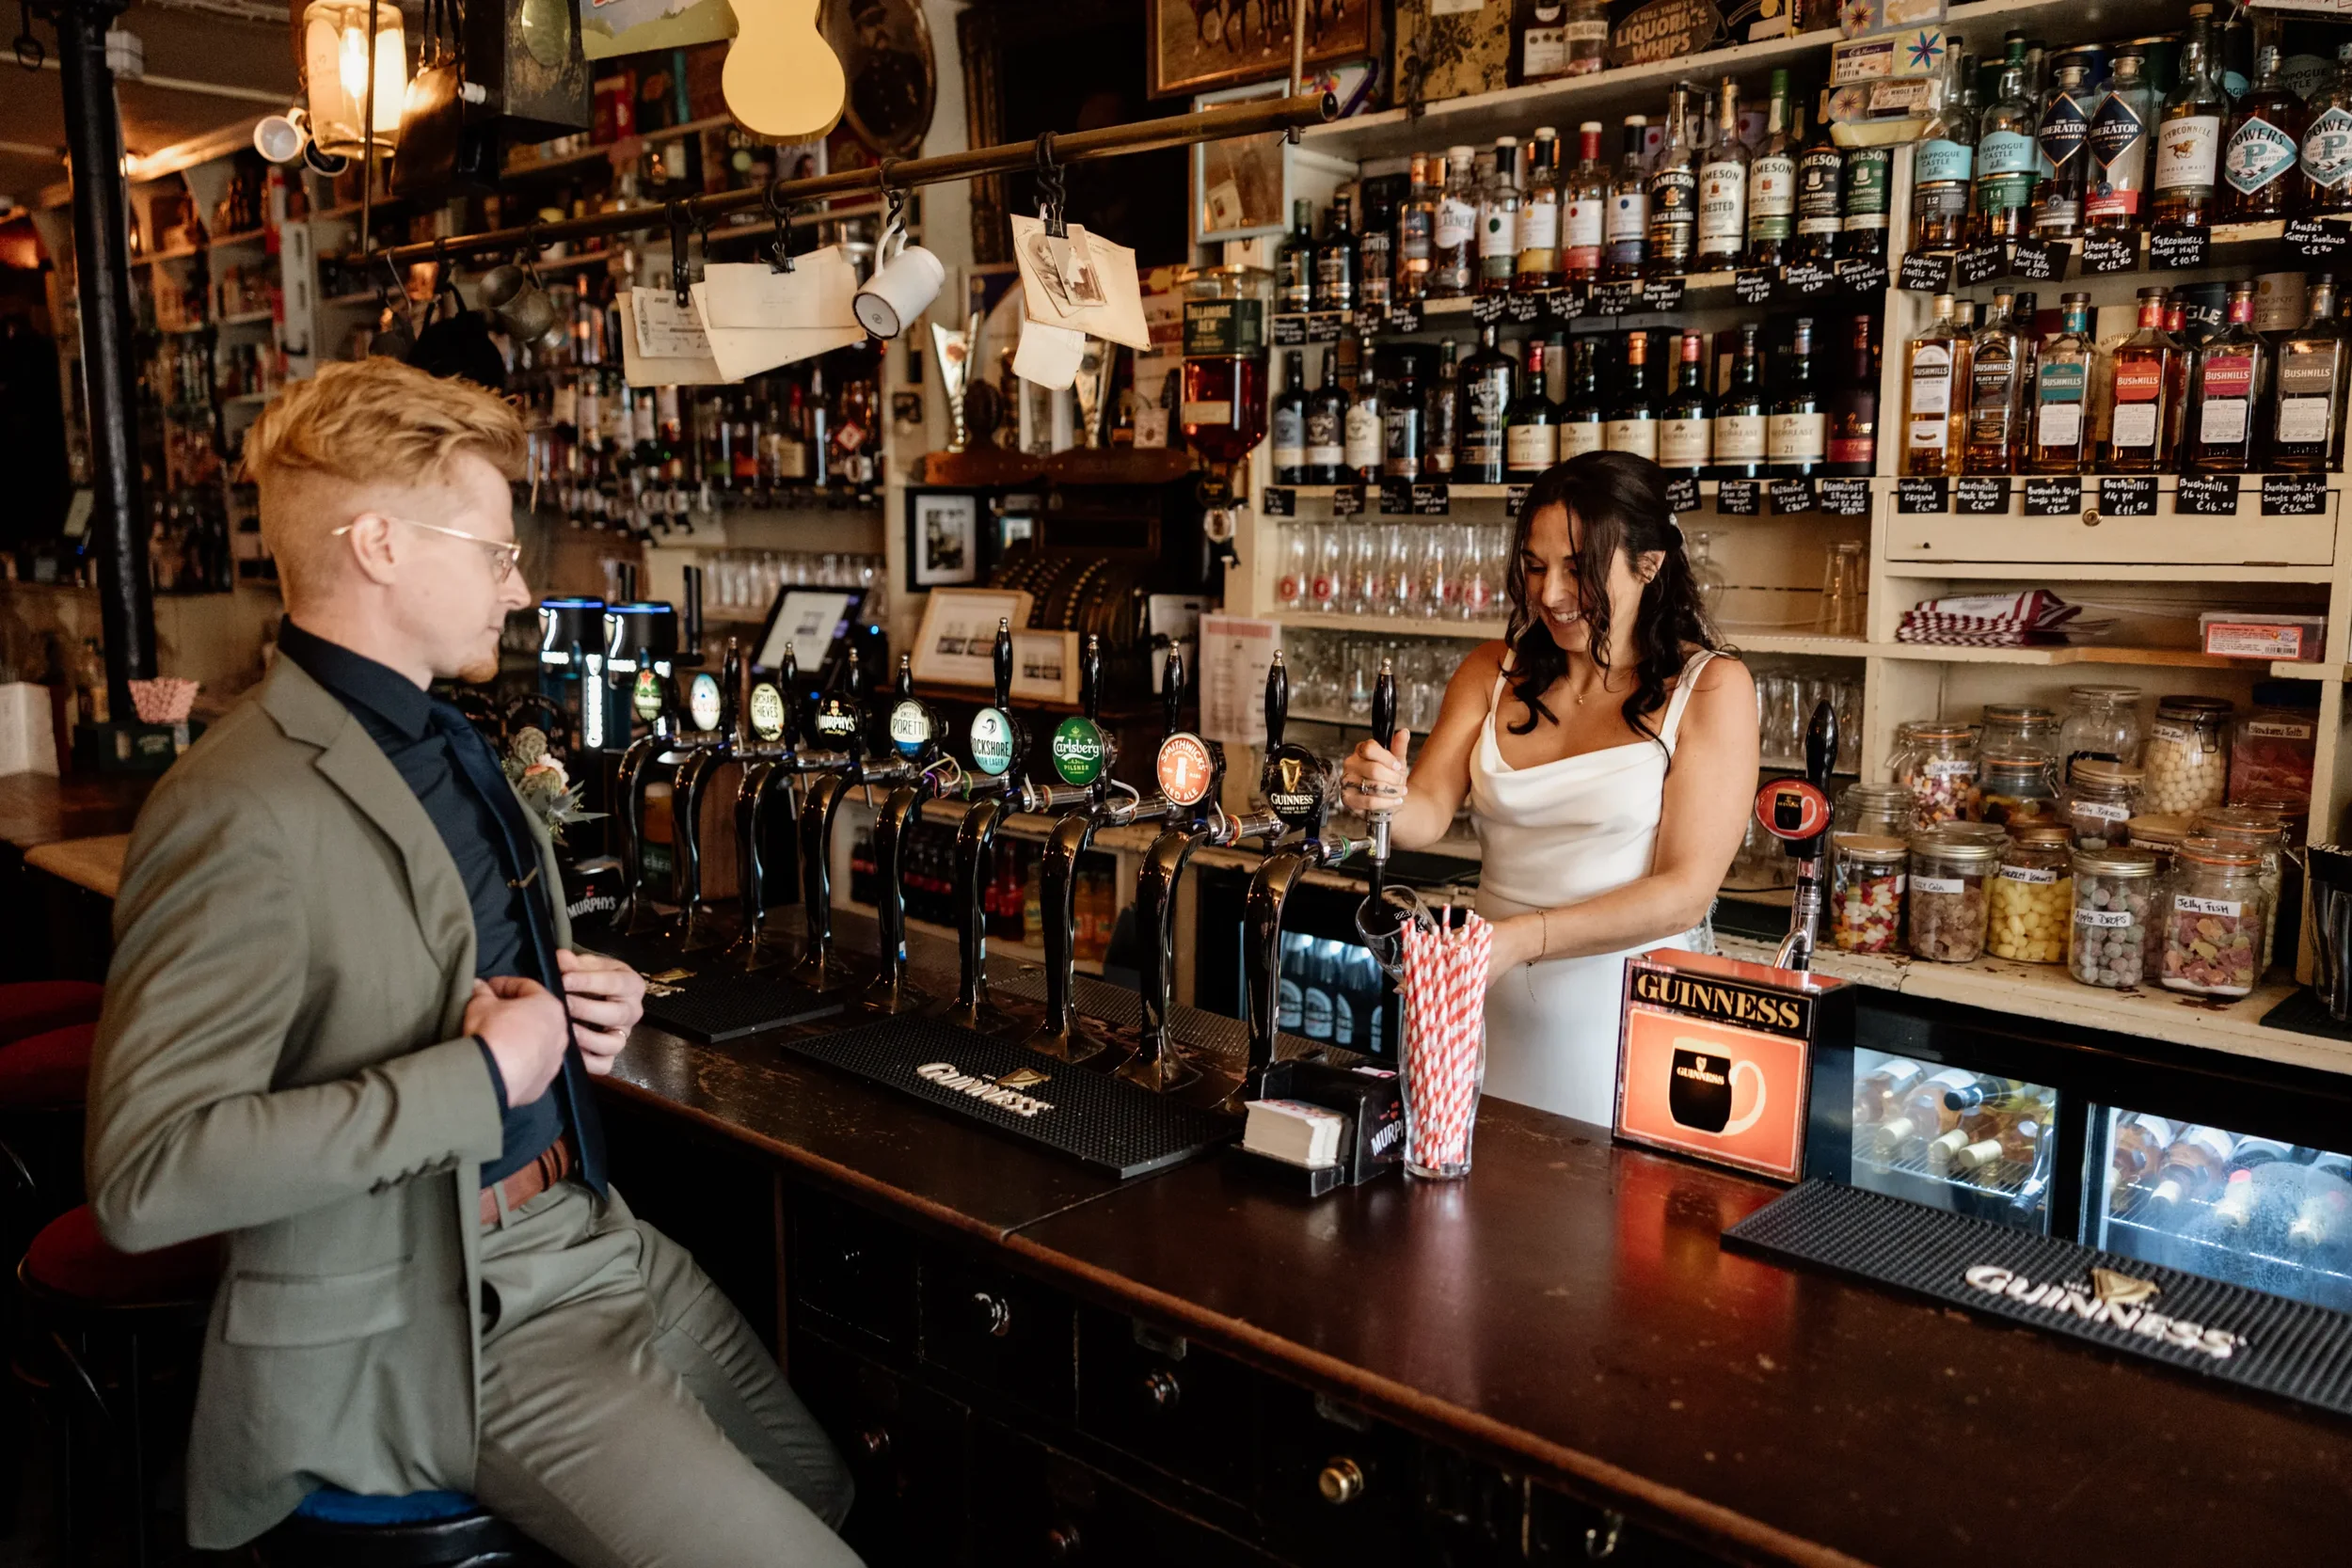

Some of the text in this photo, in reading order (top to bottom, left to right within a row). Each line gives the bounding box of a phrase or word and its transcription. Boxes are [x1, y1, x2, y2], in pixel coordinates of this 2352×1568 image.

[1632, 32, 1691, 60] WHIPS
[1891, 87, 1910, 96] WHOLE
[2039, 123, 2087, 135] LIBERATOR
[2163, 125, 2212, 142] TYRCONNELL
[2229, 127, 2286, 150] POWERS
[1984, 150, 2013, 160] CASTLE
[1927, 197, 1939, 205] 12
[1915, 367, 1948, 376] BUSHMILLS
[1974, 363, 2011, 372] BUSHMILLS
[2284, 369, 2330, 378] BUSHMILLS
[2117, 376, 2158, 386] BUSHMILLS
[2205, 371, 2249, 381] BUSHMILLS
[2042, 377, 2082, 388] BUSHMILLS
[2179, 478, 2229, 492] Bushmills
[2181, 491, 2195, 499] 16
[2115, 502, 2149, 515] €11.50
[2196, 502, 2234, 512] €16.00
[2280, 502, 2316, 514] €26.00
[753, 705, 779, 719] THIEVES
[818, 713, 856, 732] MURPHY'S
[892, 719, 924, 736] PORETTI
[1054, 736, 1102, 755] Carlsberg
[990, 758, 1004, 767] LAGER
[1165, 783, 1199, 800] RED ALE
[1271, 793, 1313, 805] GUINNESS
[2177, 898, 2201, 912] Jelly
[1637, 974, 1800, 1029] GUINNESS
[1677, 1067, 1725, 1085] GUINNESS
[916, 1063, 1056, 1117] GUINNESS
[1964, 1265, 2248, 1358] GUINNESS
